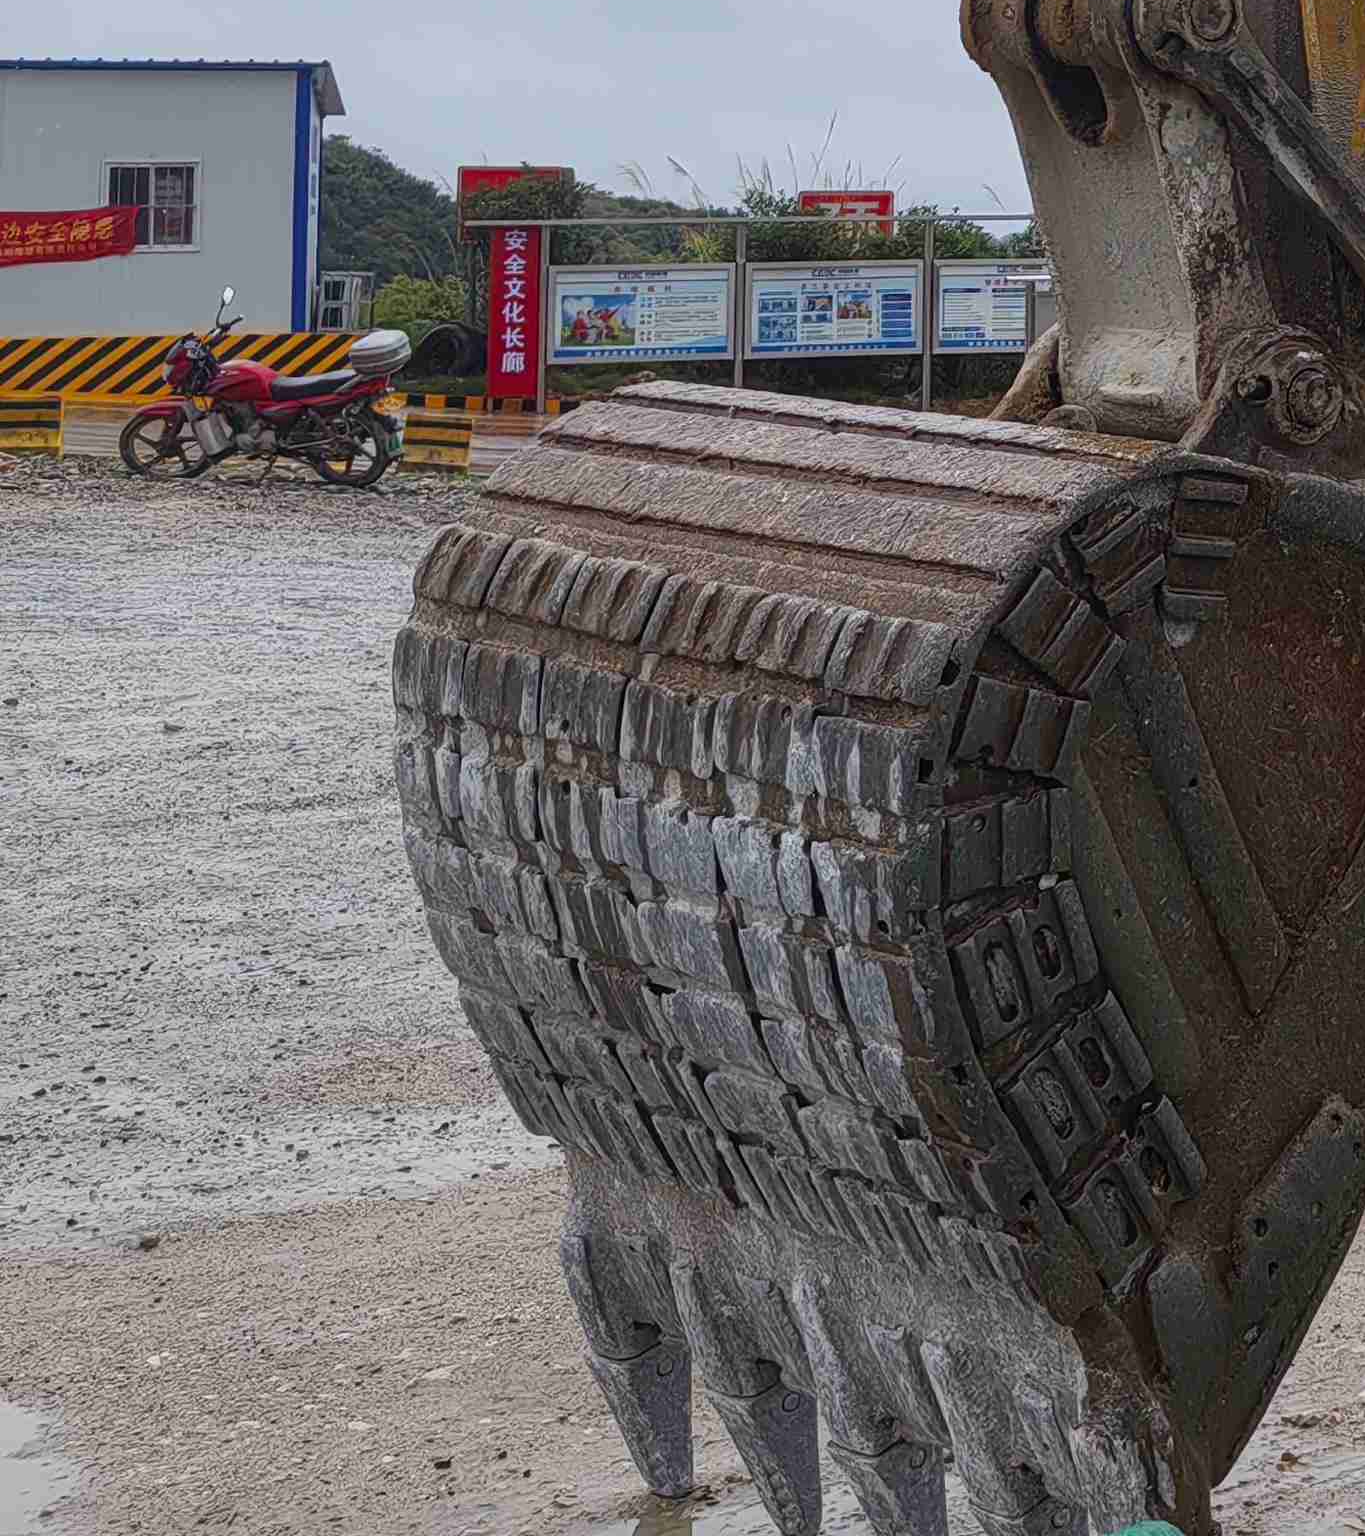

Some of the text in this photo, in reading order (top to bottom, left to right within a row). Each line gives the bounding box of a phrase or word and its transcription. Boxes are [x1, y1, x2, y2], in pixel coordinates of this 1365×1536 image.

[501, 229, 529, 374] 安全文化长廊
